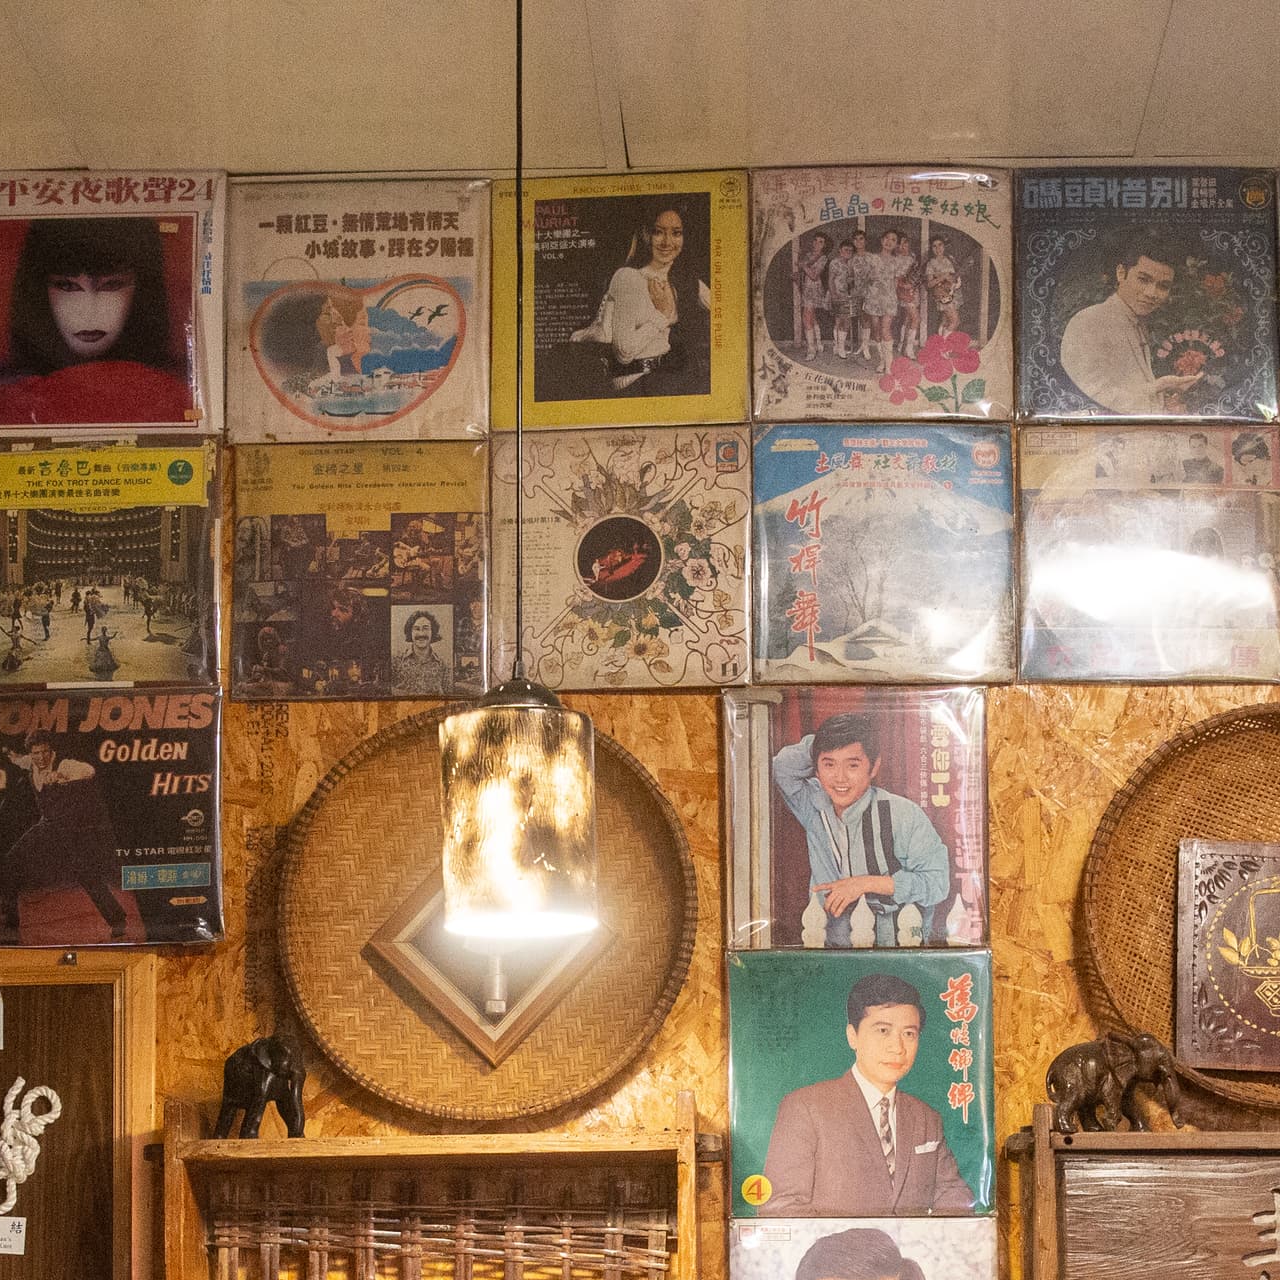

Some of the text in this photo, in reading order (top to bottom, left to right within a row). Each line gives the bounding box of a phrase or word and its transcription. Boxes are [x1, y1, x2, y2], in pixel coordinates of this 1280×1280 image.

[92, 478, 121, 486] DANCE
[75, 693, 216, 732] JONES
[116, 847, 165, 857] TV STAR
